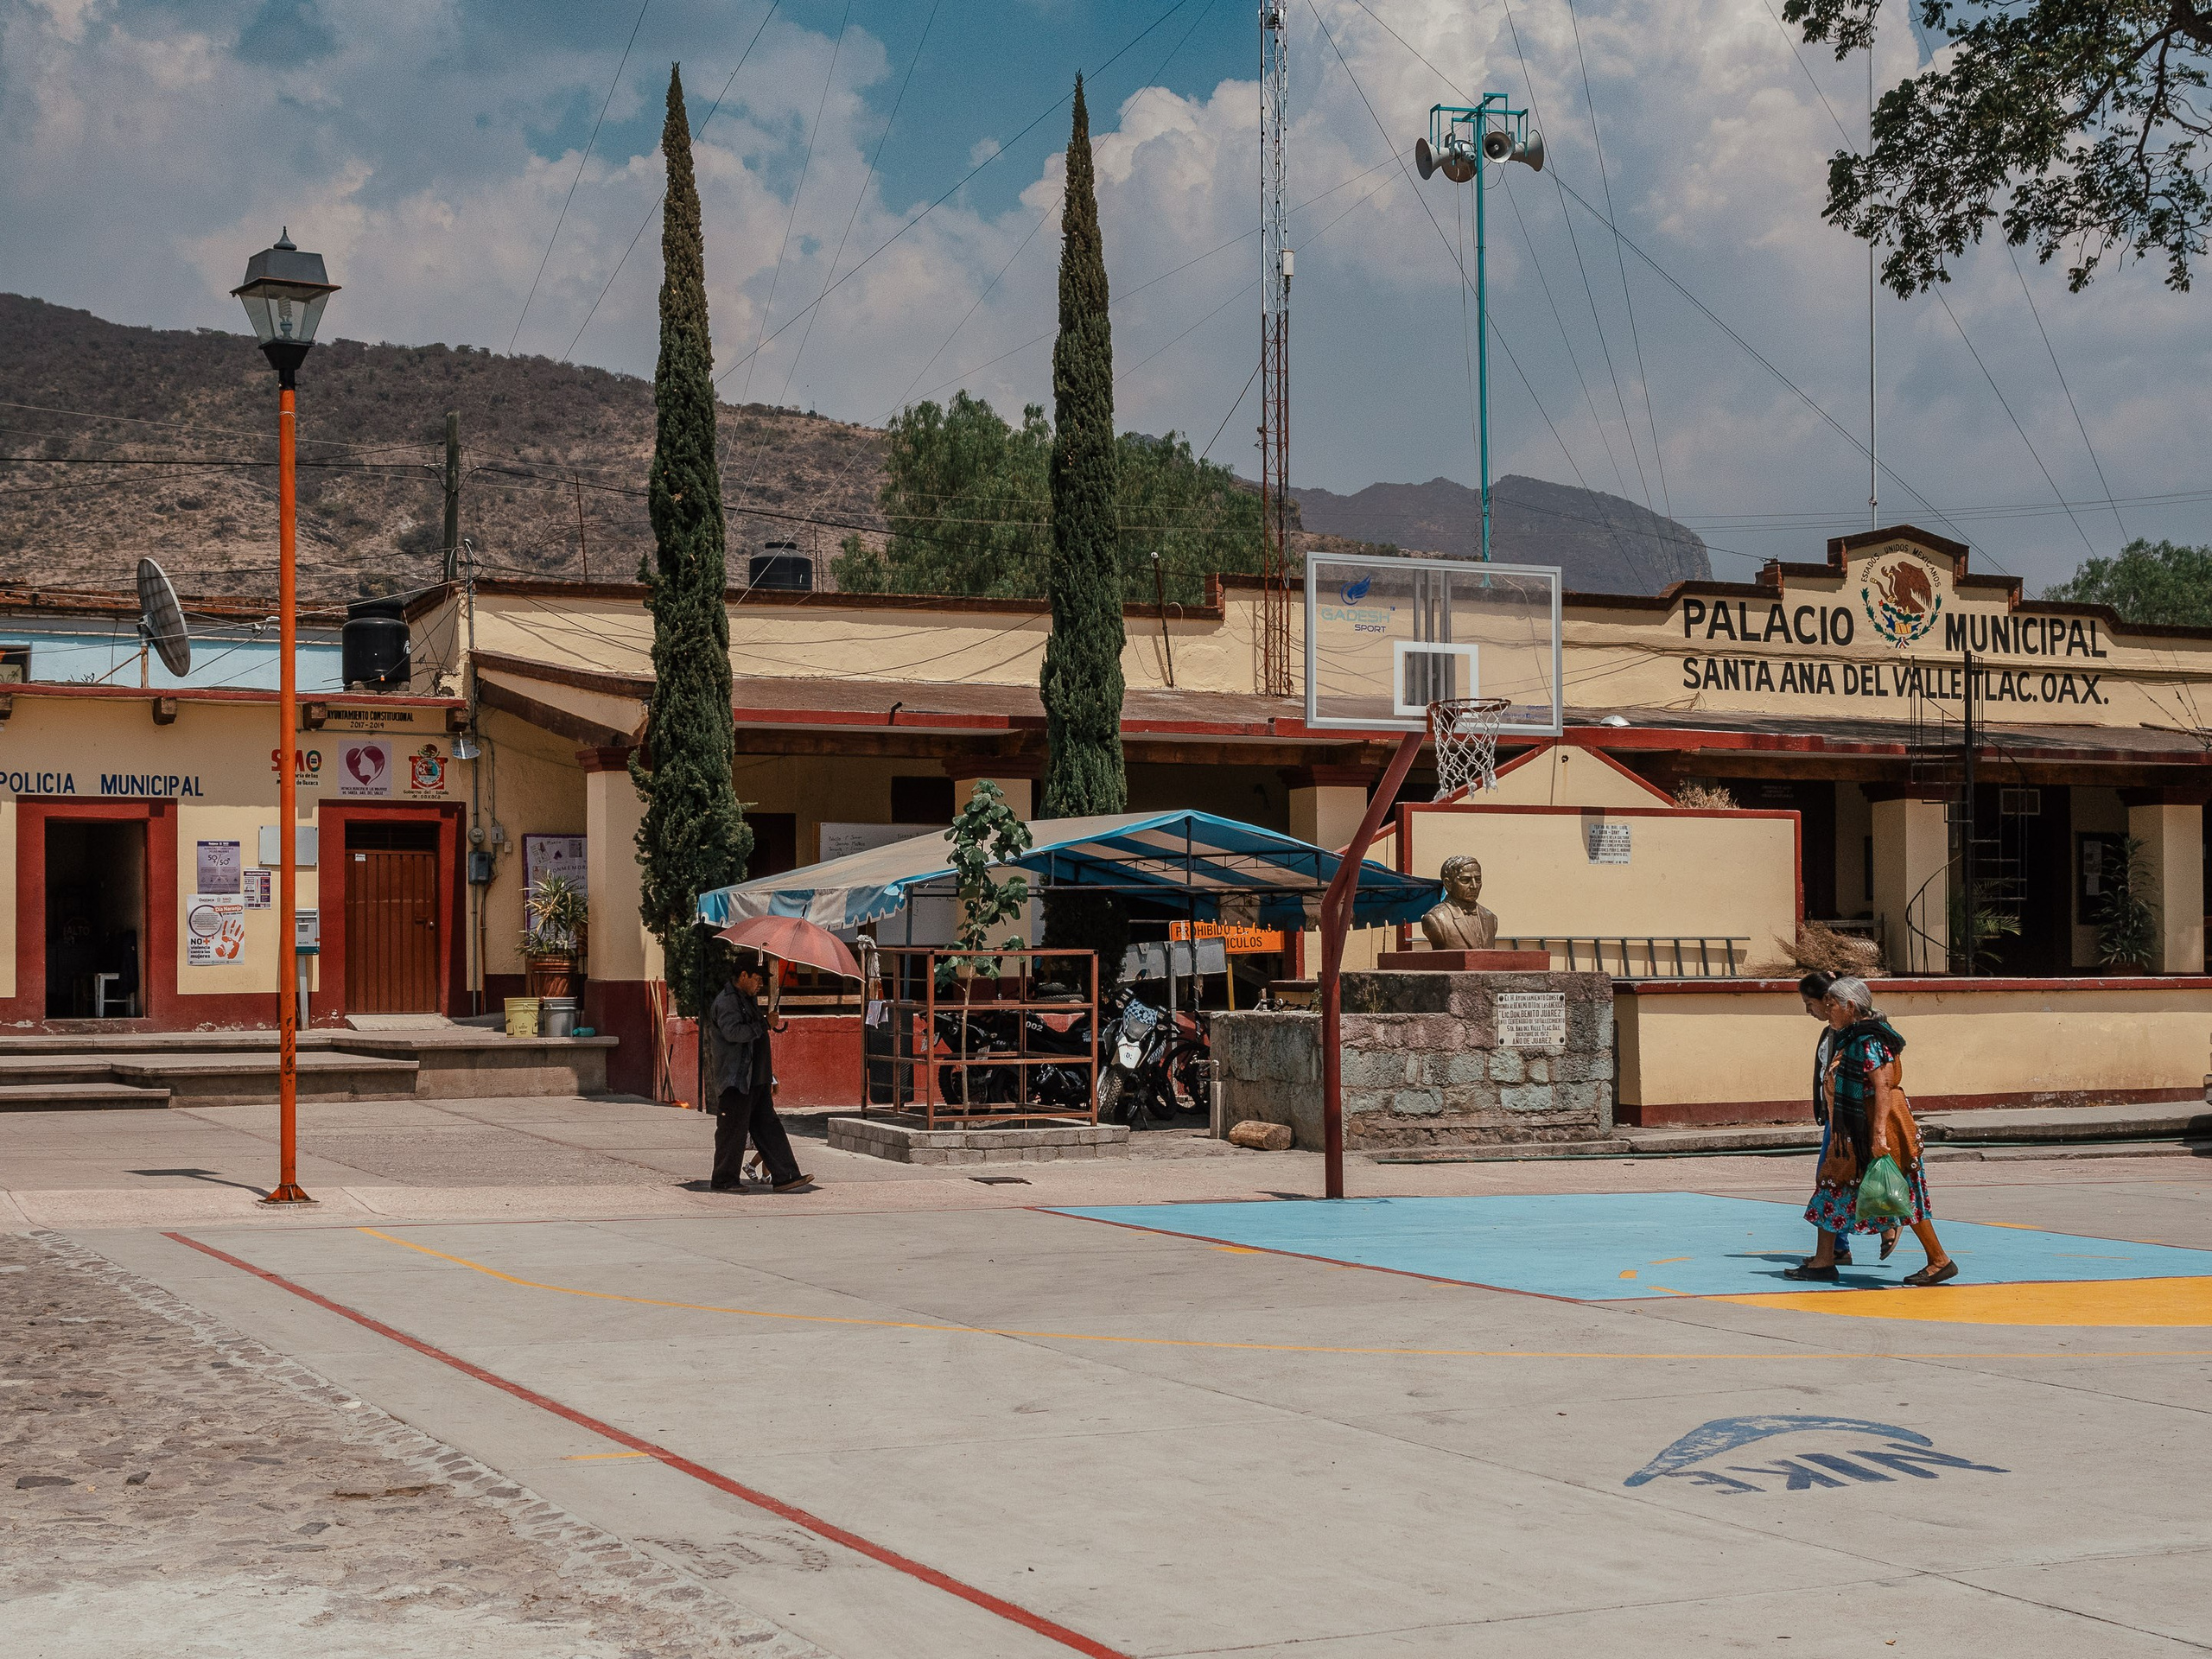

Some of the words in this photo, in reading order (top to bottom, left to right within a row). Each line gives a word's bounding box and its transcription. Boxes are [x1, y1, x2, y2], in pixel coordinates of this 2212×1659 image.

[1861, 553, 1880, 582] ESTADOS
[1885, 543, 1909, 554] UNIDOS
[1912, 548, 1942, 588] MEXICANOS
[1321, 607, 1389, 623] GADESH
[1354, 624, 1386, 632] SPORT
[1683, 598, 1854, 646] PALACIO
[1945, 613, 2107, 658] MUNICIPAL
[1683, 657, 1775, 692] SANTA
[1779, 661, 1835, 695] ANA
[1843, 664, 1889, 696] DEL
[2041, 672, 2109, 705] OAX.
[327, 710, 368, 721] AYUNTAMIENTO
[370, 711, 413, 721] CONSTITUCIONAL
[101, 773, 204, 796] MUNICIPAL
[1176, 924, 1230, 937] PRHIBIDO
[1227, 937, 1262, 949] ICULOS
[1026, 1021, 1043, 1032] 002
